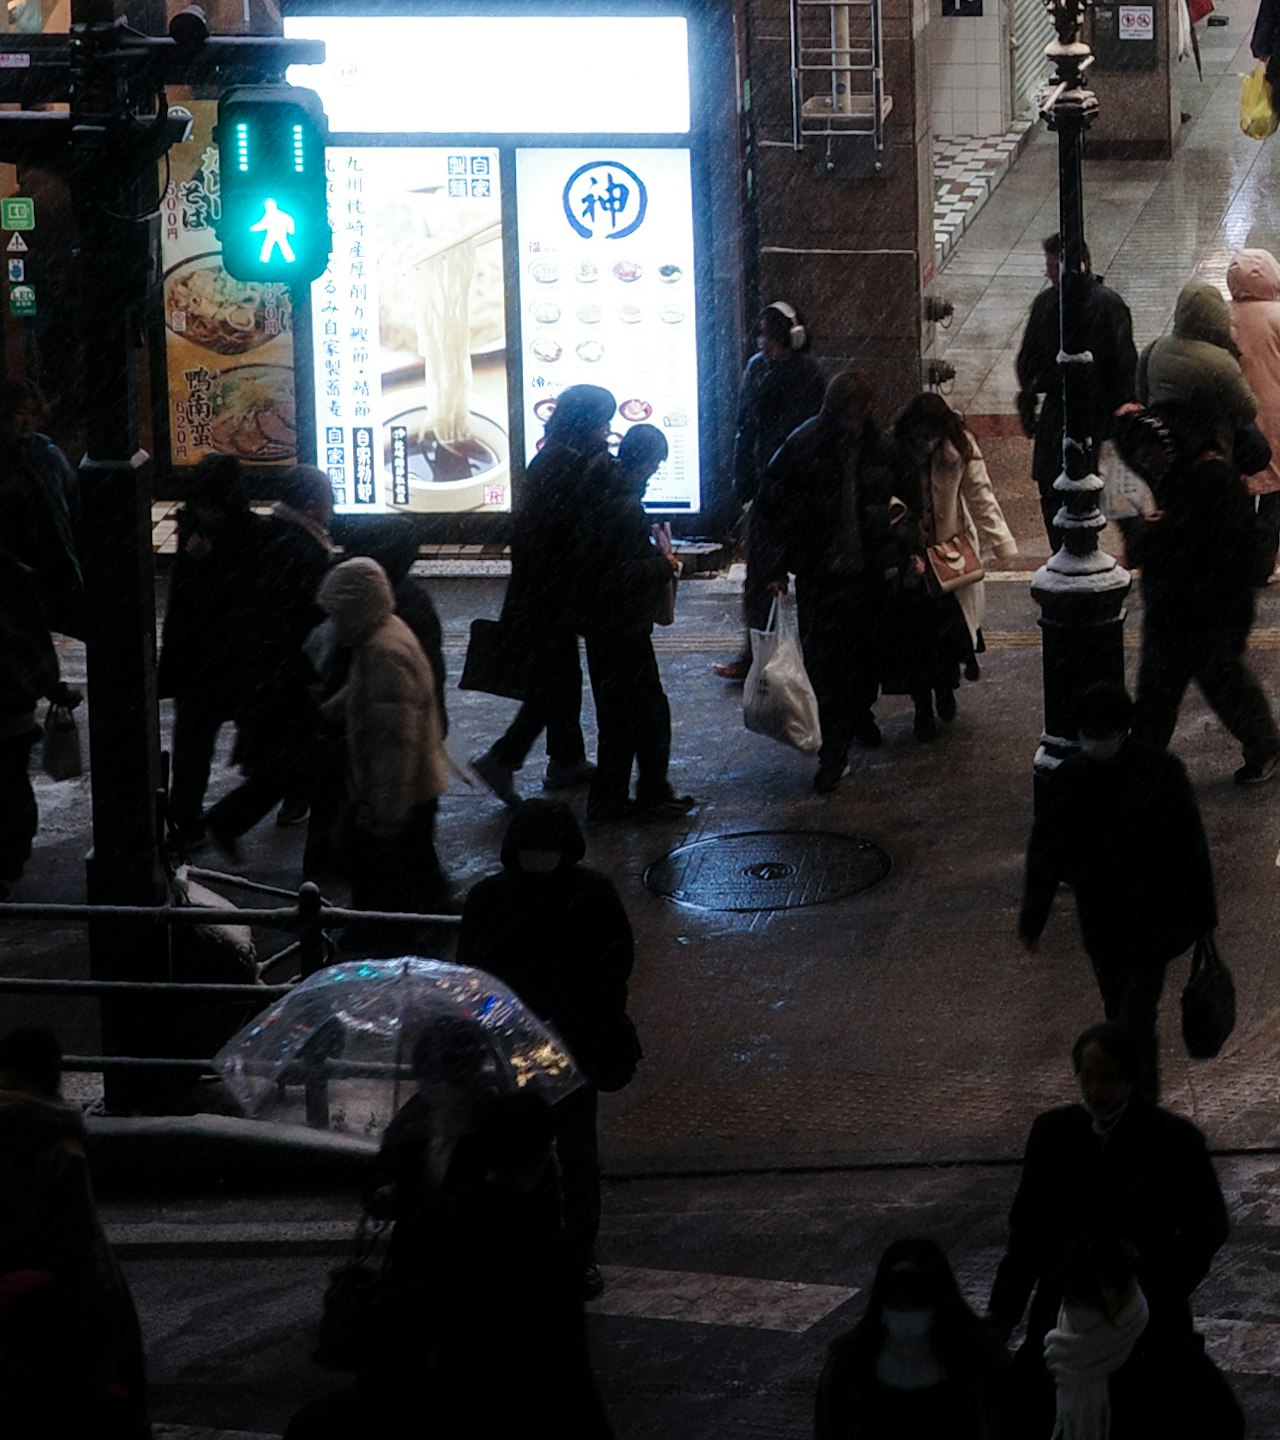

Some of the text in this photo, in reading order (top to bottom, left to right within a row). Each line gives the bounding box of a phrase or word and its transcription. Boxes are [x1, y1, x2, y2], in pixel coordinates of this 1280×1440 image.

[471, 156, 491, 198] 自家
[580, 172, 631, 230] 神
[180, 180, 207, 231] そば
[264, 283, 280, 335] 20円
[175, 401, 188, 458] 620円
[184, 366, 215, 447] 鴨南蛮
